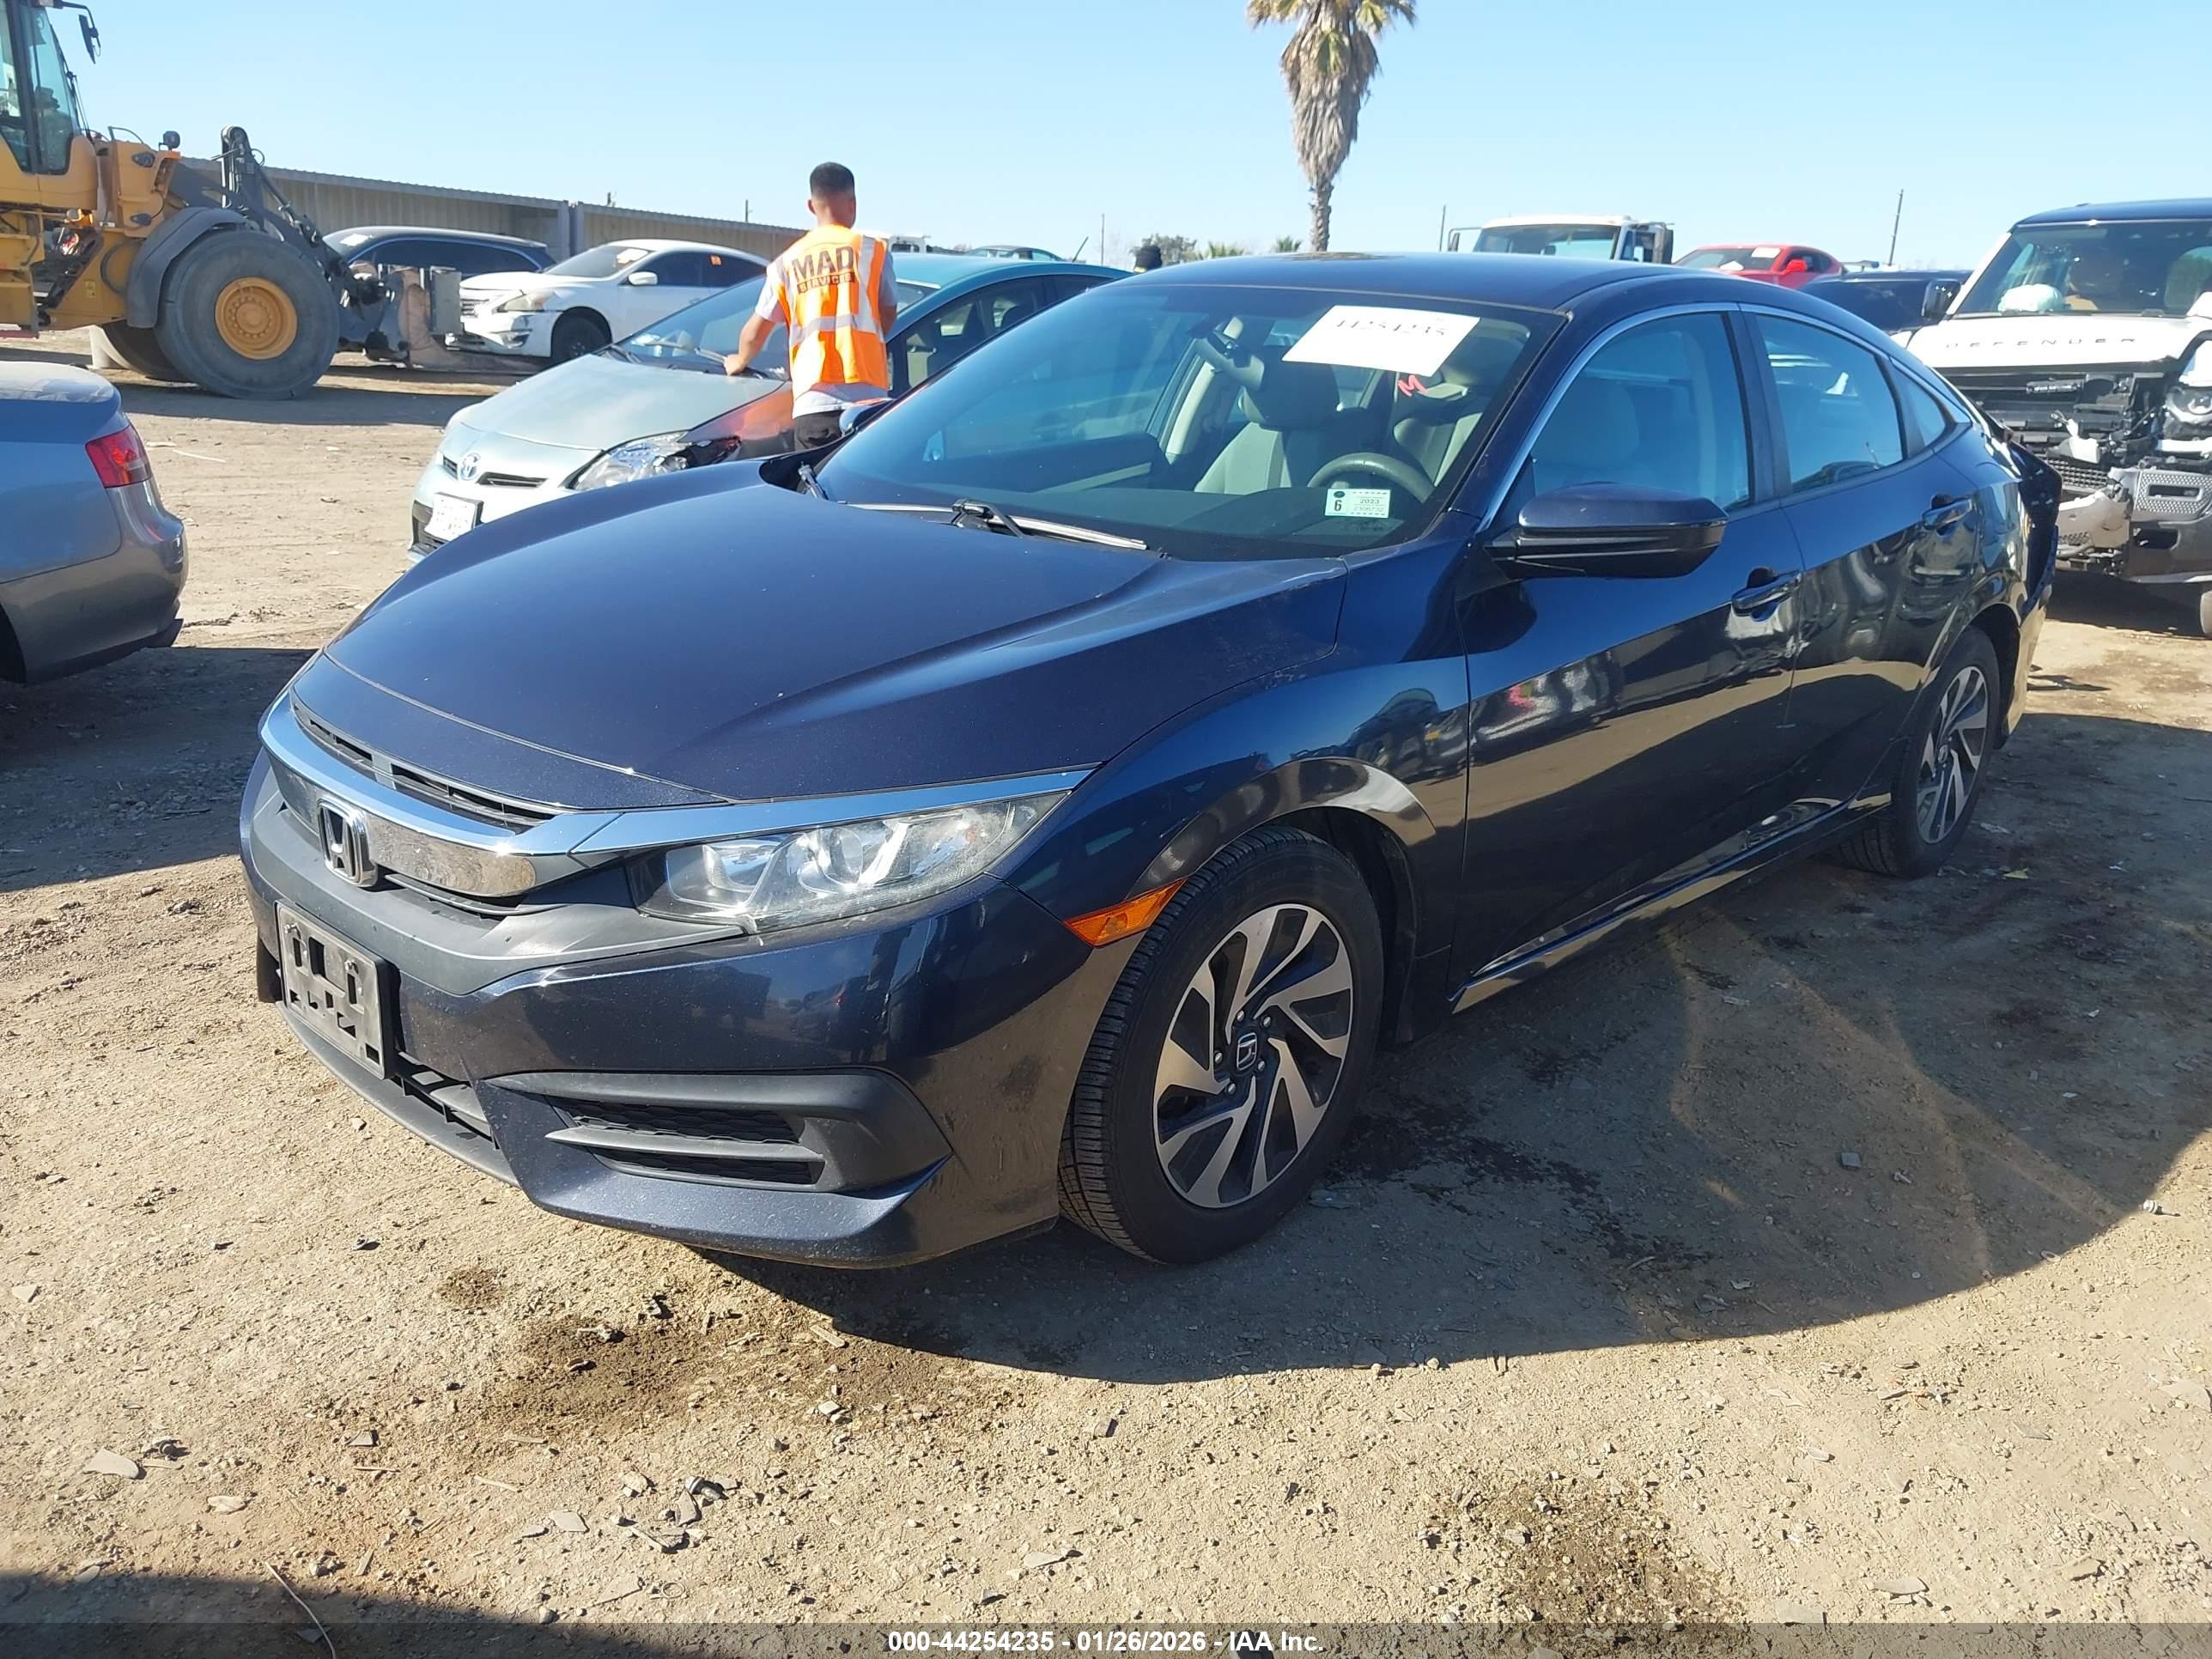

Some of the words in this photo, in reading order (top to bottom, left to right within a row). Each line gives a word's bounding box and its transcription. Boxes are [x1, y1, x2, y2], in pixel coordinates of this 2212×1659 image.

[792, 246, 854, 283] MAD
[798, 273, 854, 294] SERVICES
[1946, 337, 2136, 349] DEFENDER
[1334, 499, 1342, 512] 6
